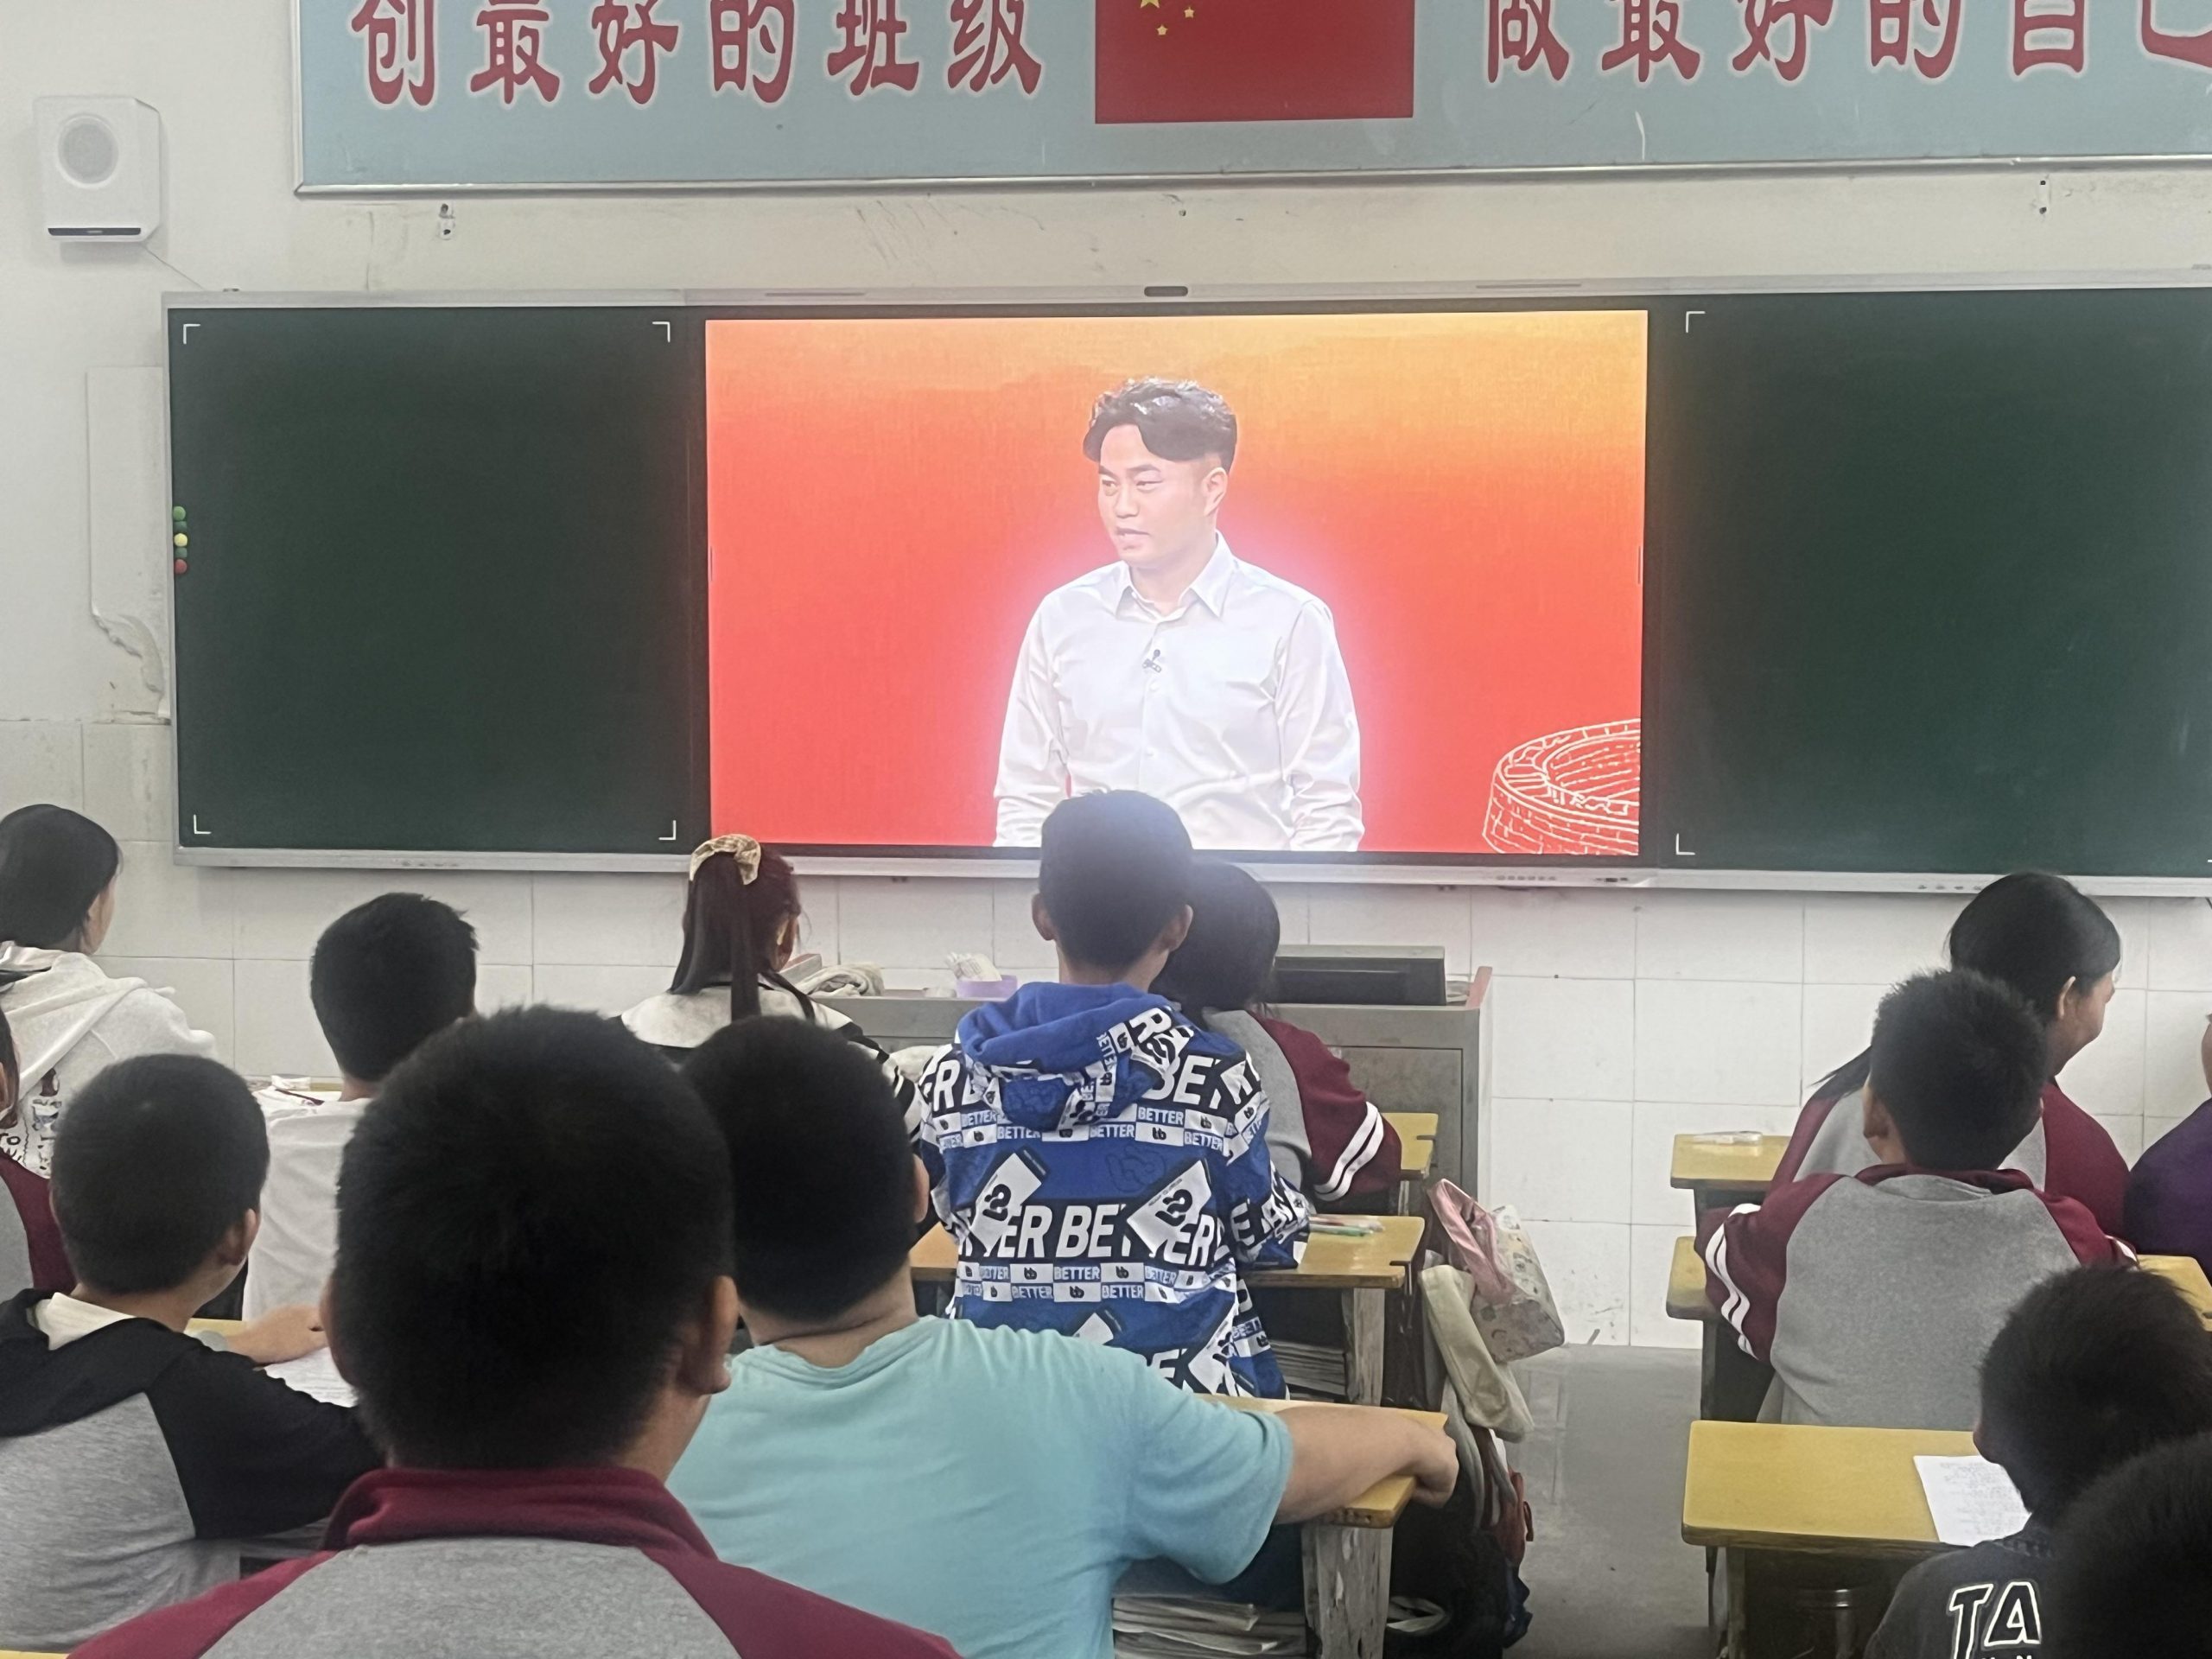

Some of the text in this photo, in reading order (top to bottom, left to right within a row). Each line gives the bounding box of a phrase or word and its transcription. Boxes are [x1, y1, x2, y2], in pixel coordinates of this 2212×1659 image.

[1138, 1106, 1185, 1126] BETTER
[1090, 1124, 1136, 1139] BETTER
[1053, 1265, 1102, 1281] BETTER
[1102, 1284, 1145, 1300] BETTER
